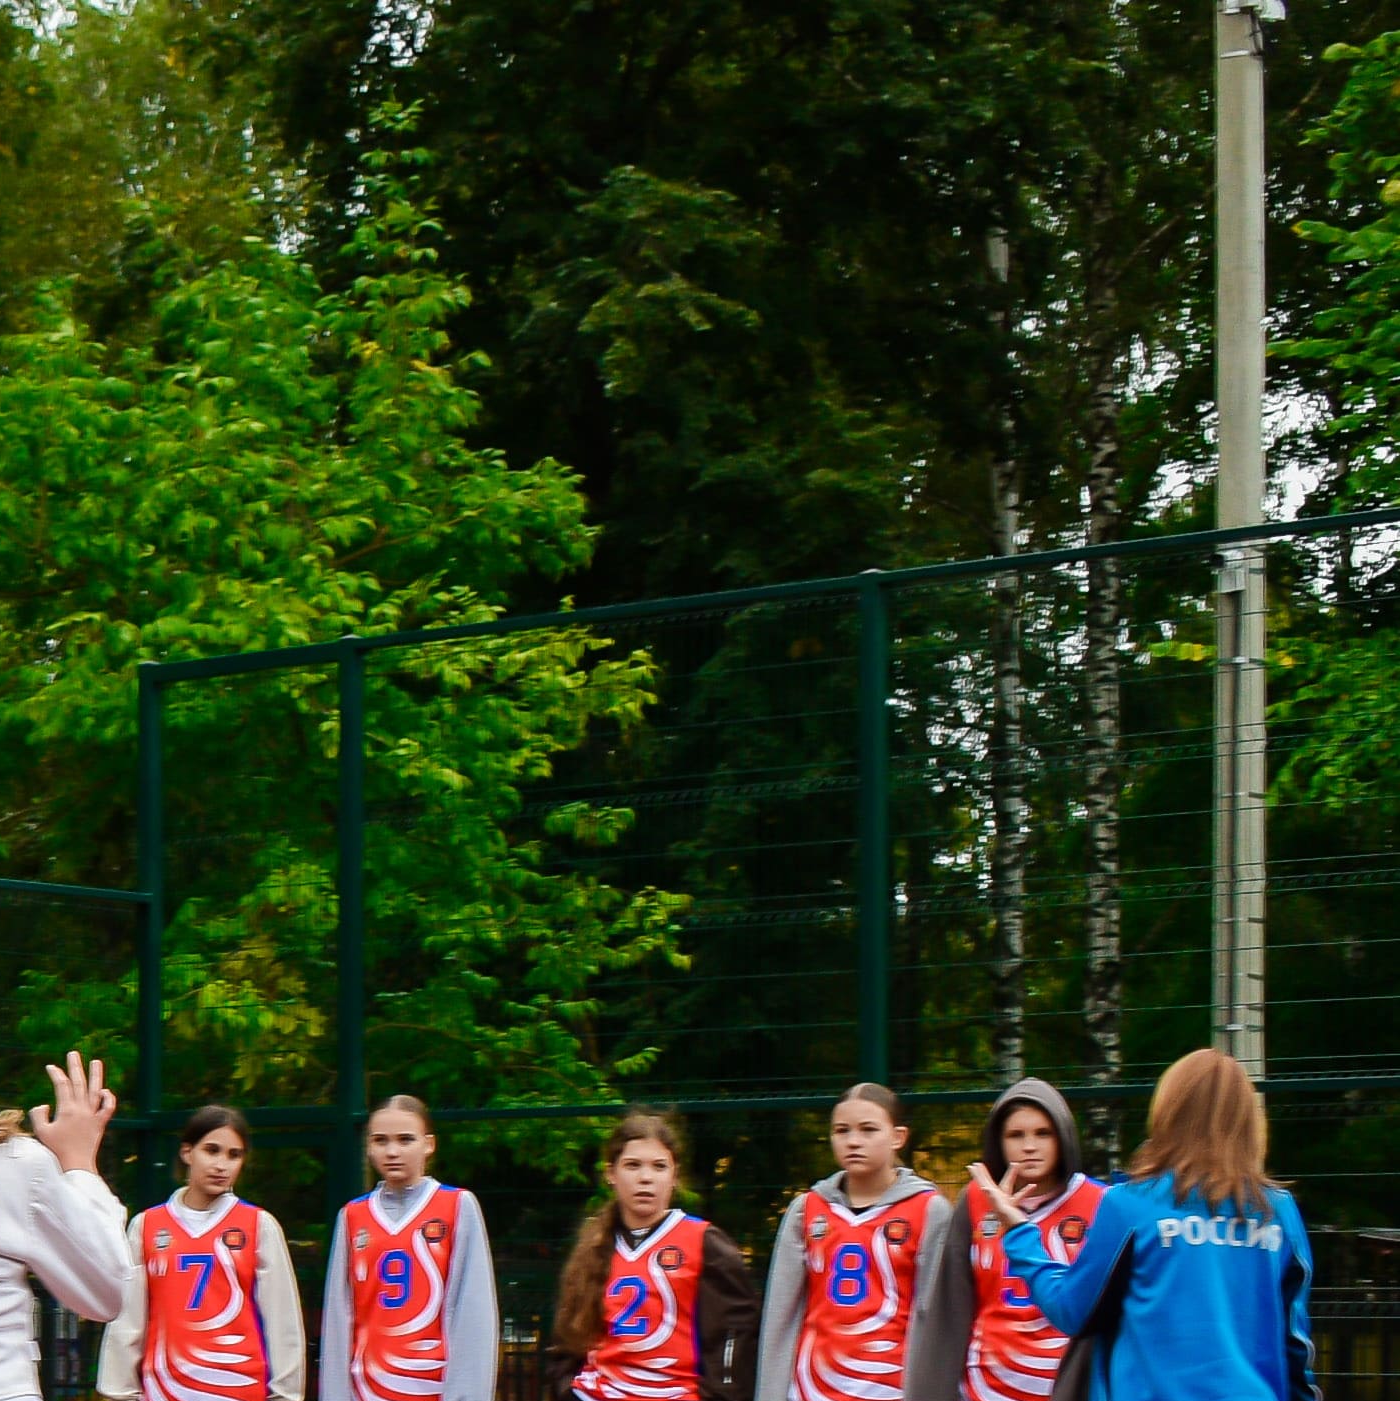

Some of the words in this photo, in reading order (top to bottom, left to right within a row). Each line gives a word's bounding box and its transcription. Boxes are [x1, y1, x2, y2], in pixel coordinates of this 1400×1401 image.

[1157, 1215, 1283, 1252] РОССИЯ
[176, 1252, 215, 1311] 7
[377, 1249, 414, 1310] 9
[827, 1242, 871, 1307] 8
[606, 1274, 650, 1337] 2
